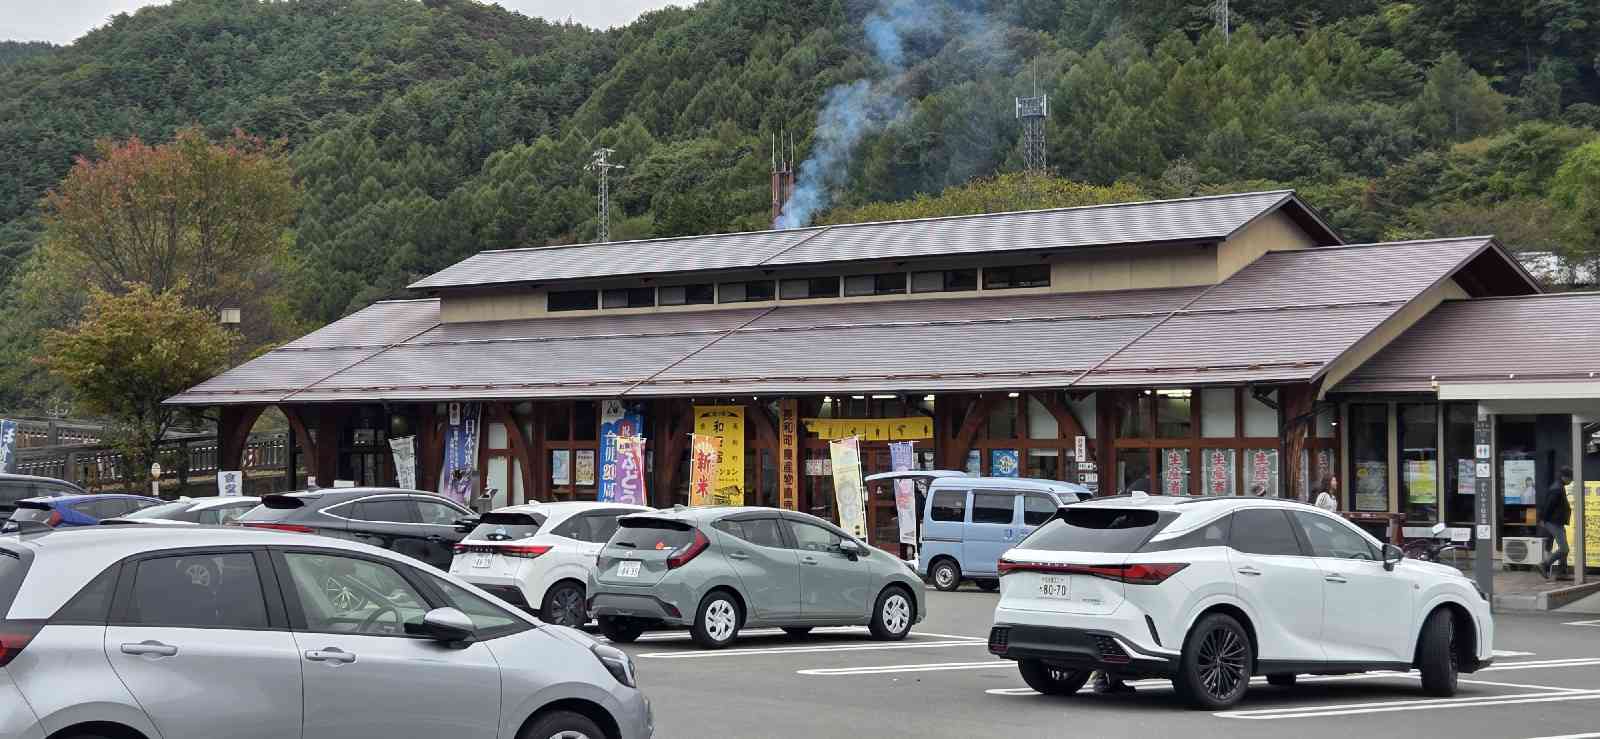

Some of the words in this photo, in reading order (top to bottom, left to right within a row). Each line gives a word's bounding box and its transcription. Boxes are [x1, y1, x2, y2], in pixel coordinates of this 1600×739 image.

[697, 449, 713, 498] 新米
[1168, 449, 1183, 496] 生産者
[1211, 449, 1226, 495] 生産者
[1043, 584, 1066, 596] 80-70
